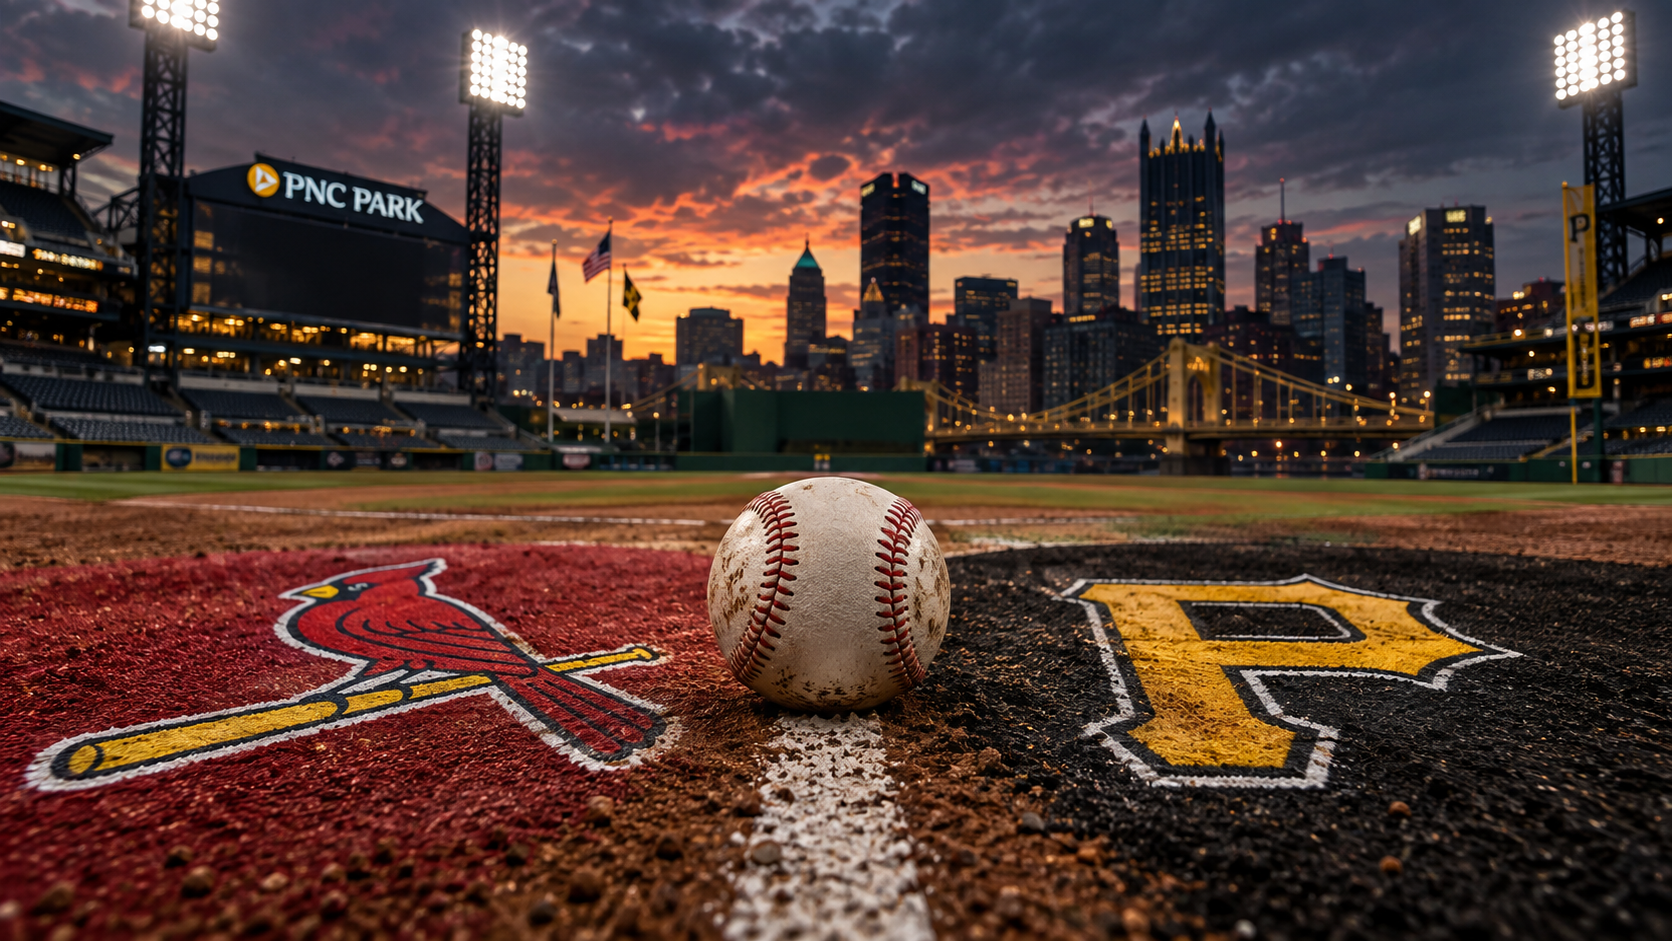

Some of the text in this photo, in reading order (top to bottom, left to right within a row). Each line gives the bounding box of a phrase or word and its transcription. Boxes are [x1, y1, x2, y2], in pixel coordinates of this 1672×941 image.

[283, 171, 424, 224] PNC PARK
[1569, 212, 1591, 243] P
[1054, 574, 1523, 788] P
